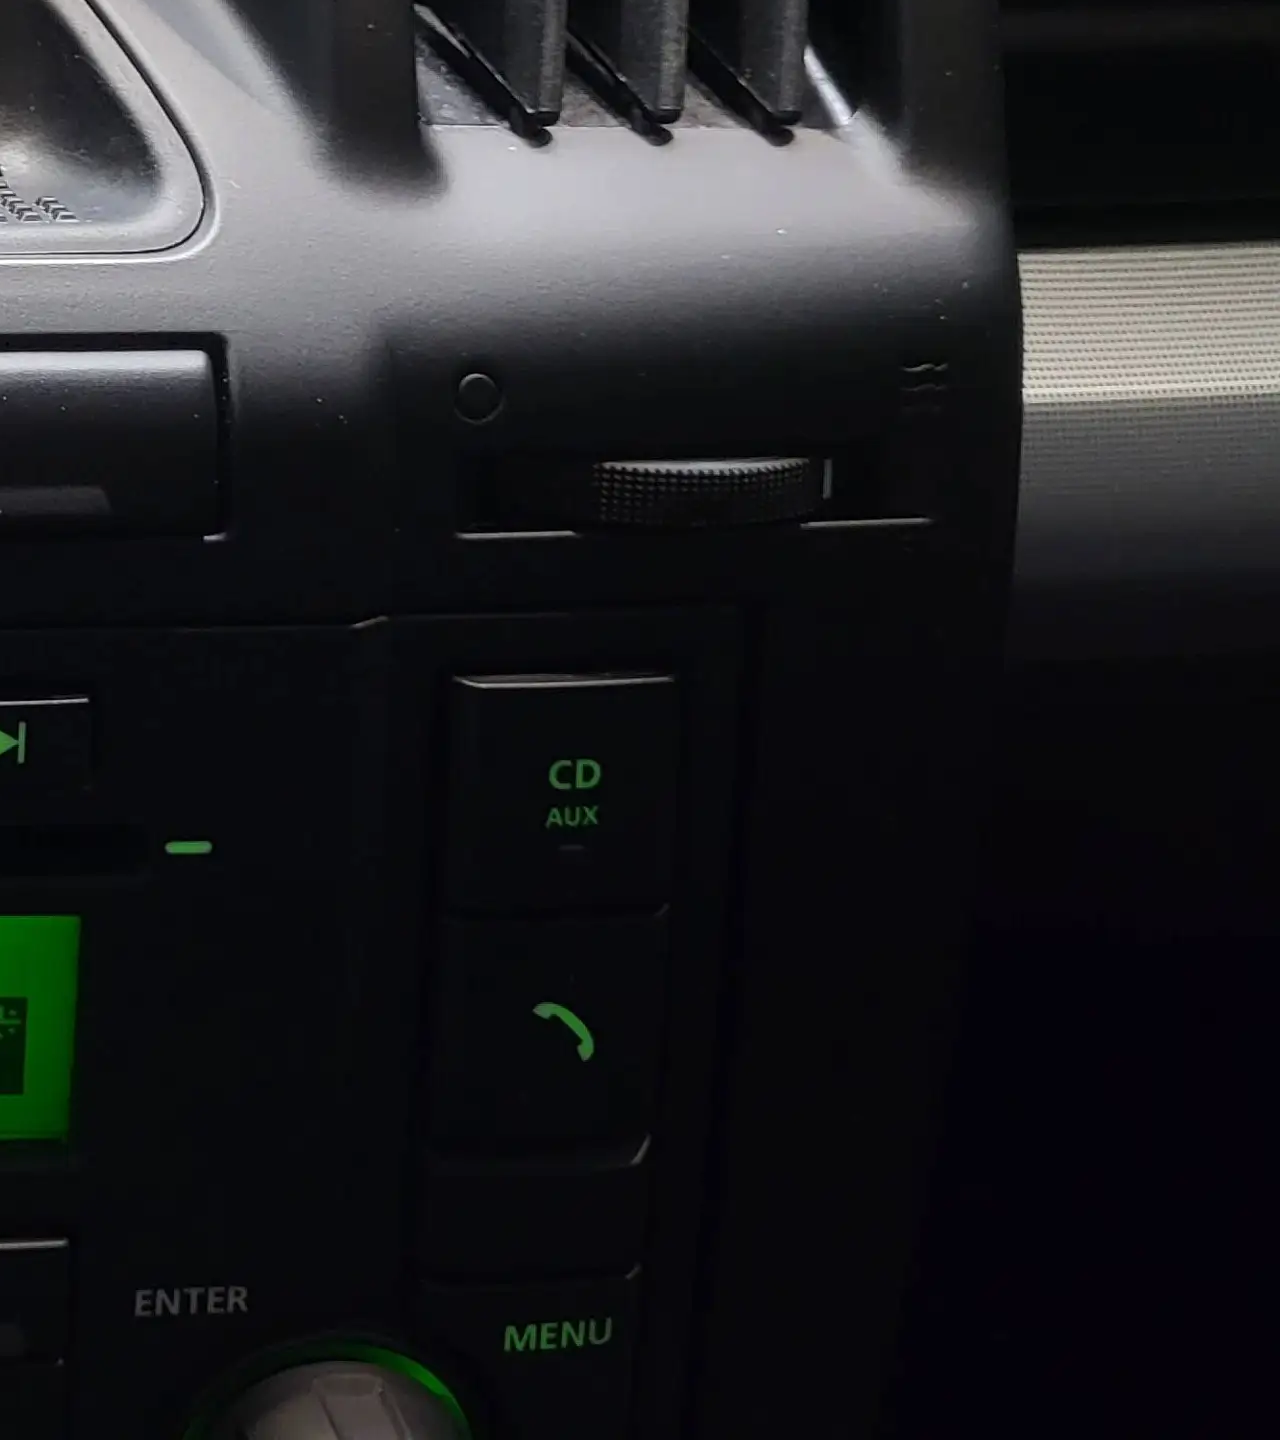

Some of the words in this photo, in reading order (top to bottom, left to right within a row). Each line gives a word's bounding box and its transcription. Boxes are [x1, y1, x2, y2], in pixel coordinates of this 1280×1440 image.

[548, 759, 601, 790] CD
[546, 805, 598, 828] AUX
[134, 1286, 248, 1317] ENTER
[503, 1317, 612, 1352] MENU
